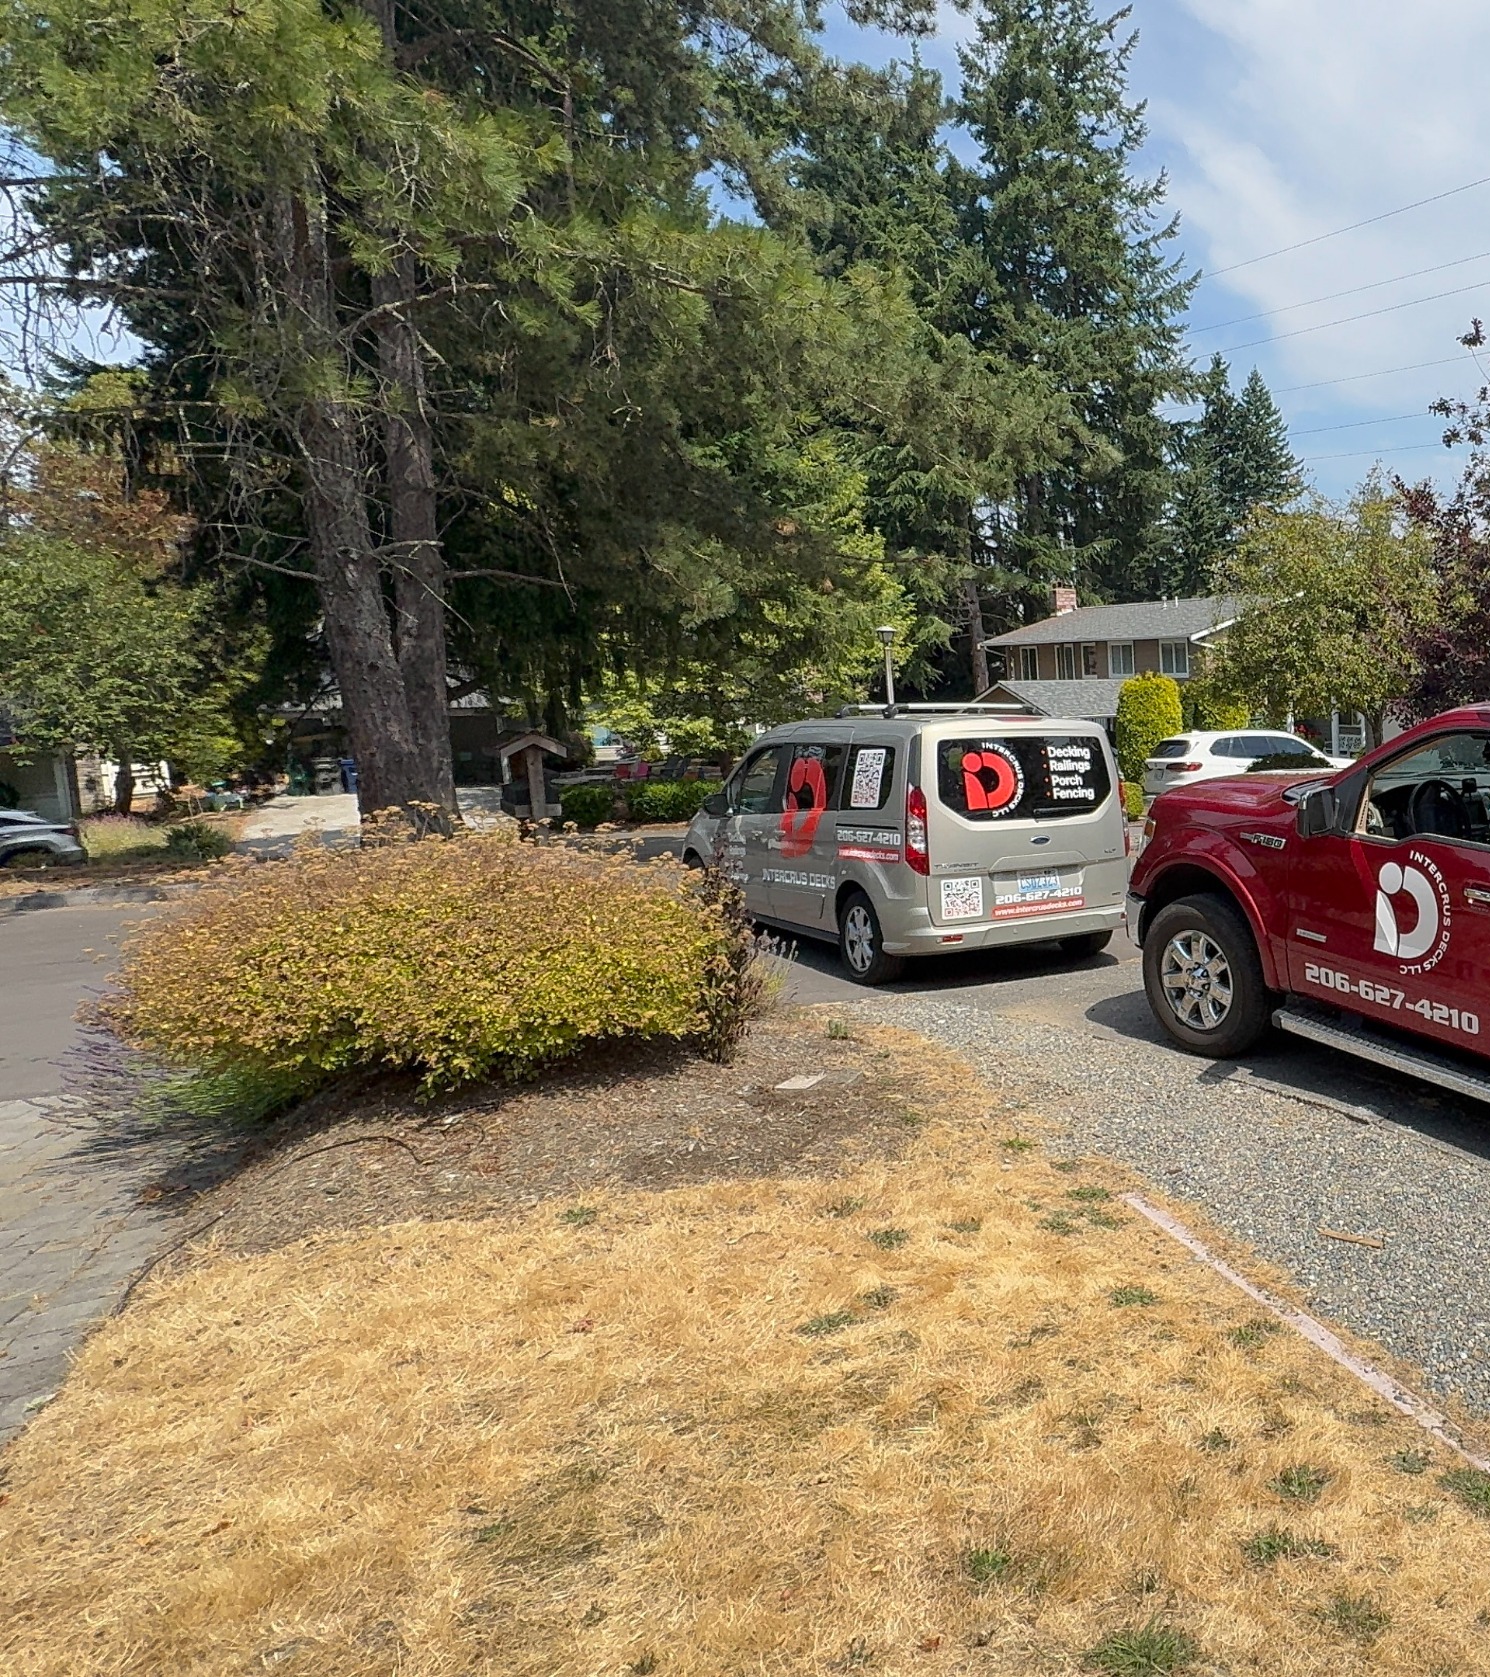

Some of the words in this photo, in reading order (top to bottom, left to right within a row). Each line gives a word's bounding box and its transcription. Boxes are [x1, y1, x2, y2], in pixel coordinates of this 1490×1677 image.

[1047, 745, 1090, 760] Decking
[981, 742, 1024, 783] INTERCRUS
[1049, 760, 1091, 773] Railings
[1051, 774, 1083, 786] Porch
[1053, 787, 1095, 800] Fencing
[992, 808, 1010, 818] LLC
[837, 829, 901, 846] 206-627-4210
[809, 872, 836, 890] DECKS
[1410, 850, 1451, 927] INTERCRUS
[995, 886, 1082, 905] 206-627-4210
[1423, 930, 1450, 971] DECKS
[1399, 965, 1421, 975] LLC
[1305, 962, 1479, 1035] 206-627-4210
